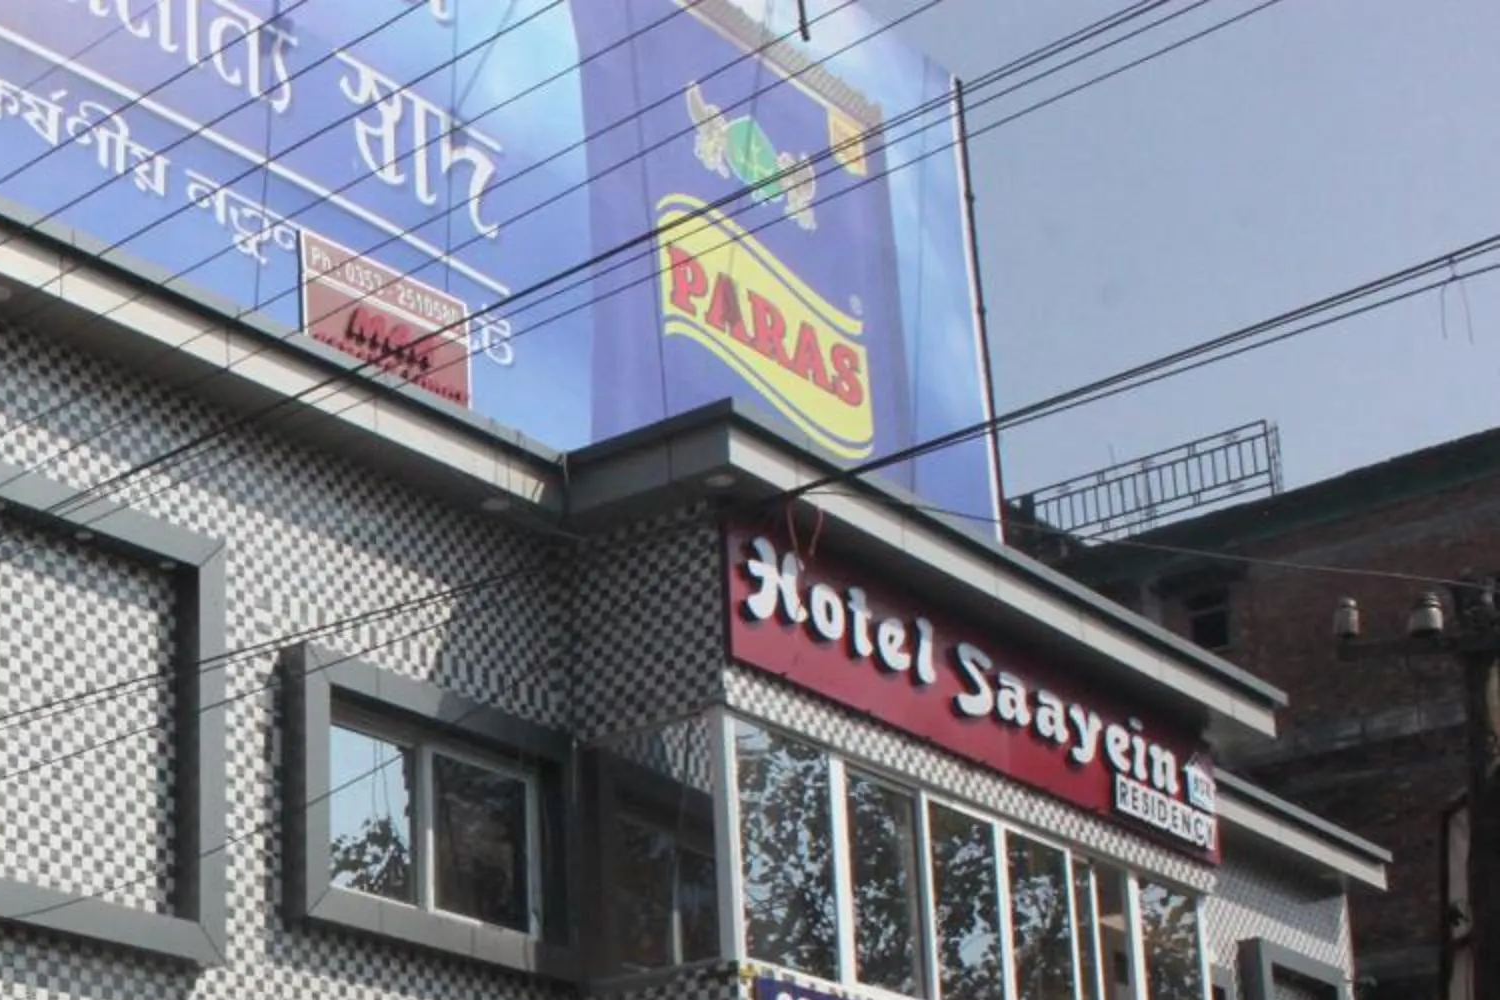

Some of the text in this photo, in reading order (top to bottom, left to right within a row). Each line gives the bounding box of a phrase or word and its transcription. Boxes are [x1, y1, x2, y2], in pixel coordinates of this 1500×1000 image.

[667, 242, 864, 408] PARAS
[746, 537, 1179, 795] Hotel Saayein
[1116, 777, 1215, 847] RESIDENCY
